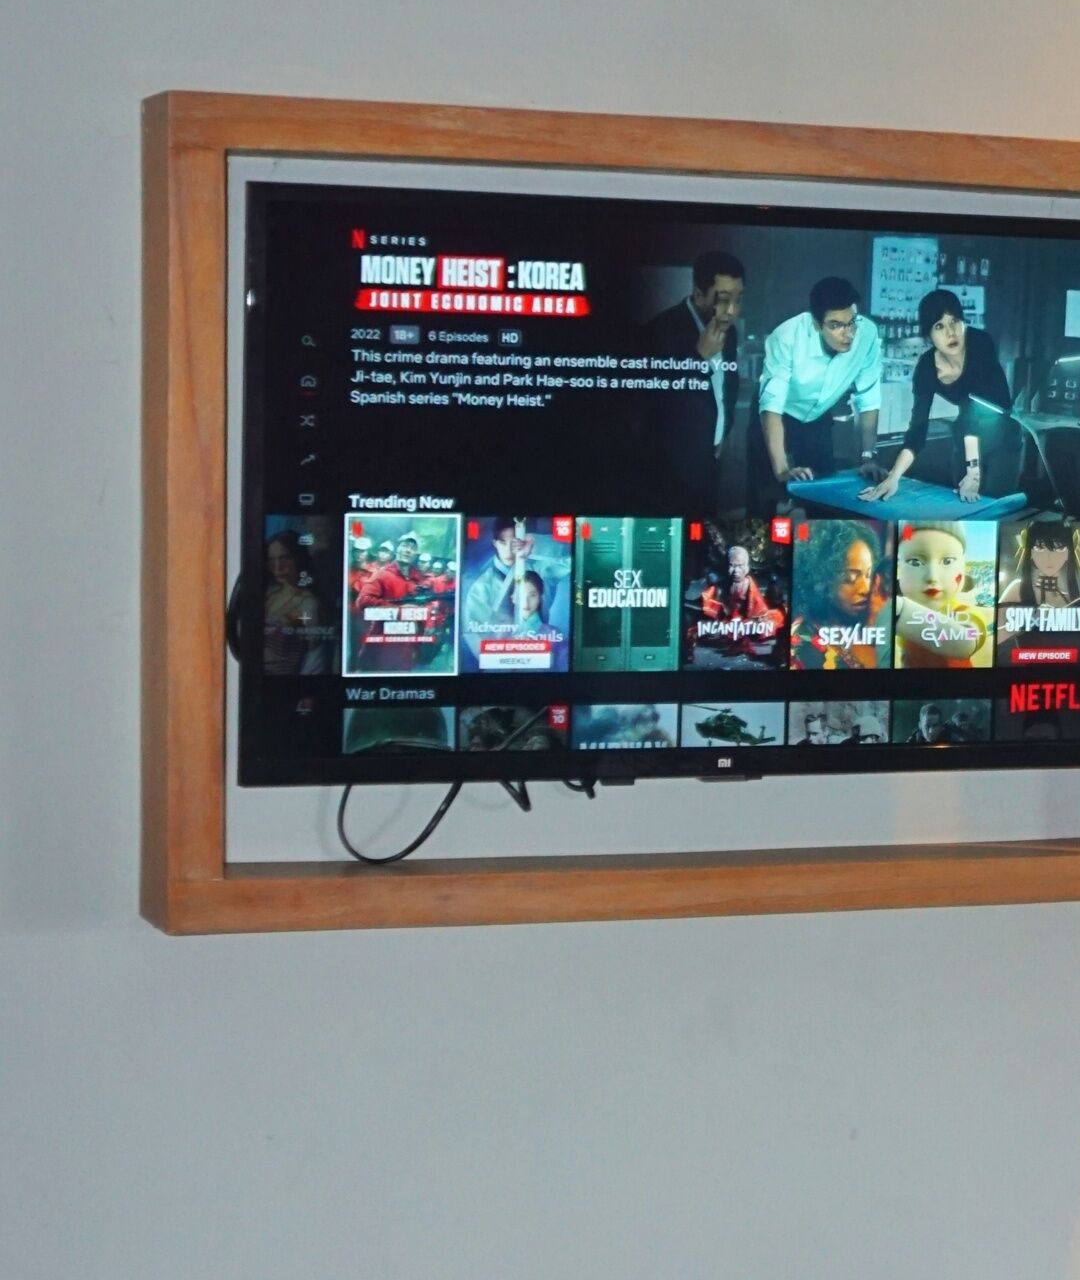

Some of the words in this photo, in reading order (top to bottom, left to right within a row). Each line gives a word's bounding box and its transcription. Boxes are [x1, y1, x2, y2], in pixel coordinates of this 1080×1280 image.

[370, 235, 427, 246] SERIES
[361, 255, 436, 285] MONEY
[441, 257, 502, 289] HEIST
[369, 291, 422, 308] JOINT
[430, 293, 524, 312] ECONOMIC
[531, 297, 576, 314] AREA
[350, 329, 381, 340] 2022
[393, 329, 414, 341] 18+
[428, 331, 437, 342] 6
[439, 331, 489, 344] Episodes
[501, 333, 519, 344] HD
[351, 349, 381, 363] This
[384, 350, 422, 364] crime
[425, 351, 469, 365] drama
[471, 352, 532, 369] featuring
[534, 357, 550, 367] an
[553, 355, 617, 369] ensemble
[620, 357, 648, 370] cast
[650, 357, 708, 373] including
[711, 359, 738, 372] Yoo
[350, 370, 396, 385] Ji-tae,
[400, 372, 426, 385] Kim
[429, 372, 471, 387] Yunjin
[474, 373, 499, 386] and
[503, 374, 533, 387] Park
[536, 375, 593, 388] Hae-soo
[596, 376, 607, 389] is
[610, 379, 618, 389] a
[621, 377, 670, 390] remake
[672, 377, 686, 390] of
[688, 378, 709, 391] the
[350, 391, 405, 406] Spanish
[408, 392, 449, 406] series
[452, 393, 503, 408] "Money
[507, 394, 551, 407] Heist."
[349, 495, 416, 511] Trending
[419, 496, 454, 509] Now
[613, 570, 642, 588] SEX
[588, 588, 667, 608] EDUCATION
[907, 605, 970, 630] SQUID
[526, 630, 563, 642] Souls
[698, 618, 774, 640] INCANTATION
[921, 627, 983, 646] GAME
[1018, 652, 1036, 660] NEW
[1037, 652, 1071, 660] EPISODE
[346, 688, 375, 700] War
[379, 687, 435, 701] Dramas
